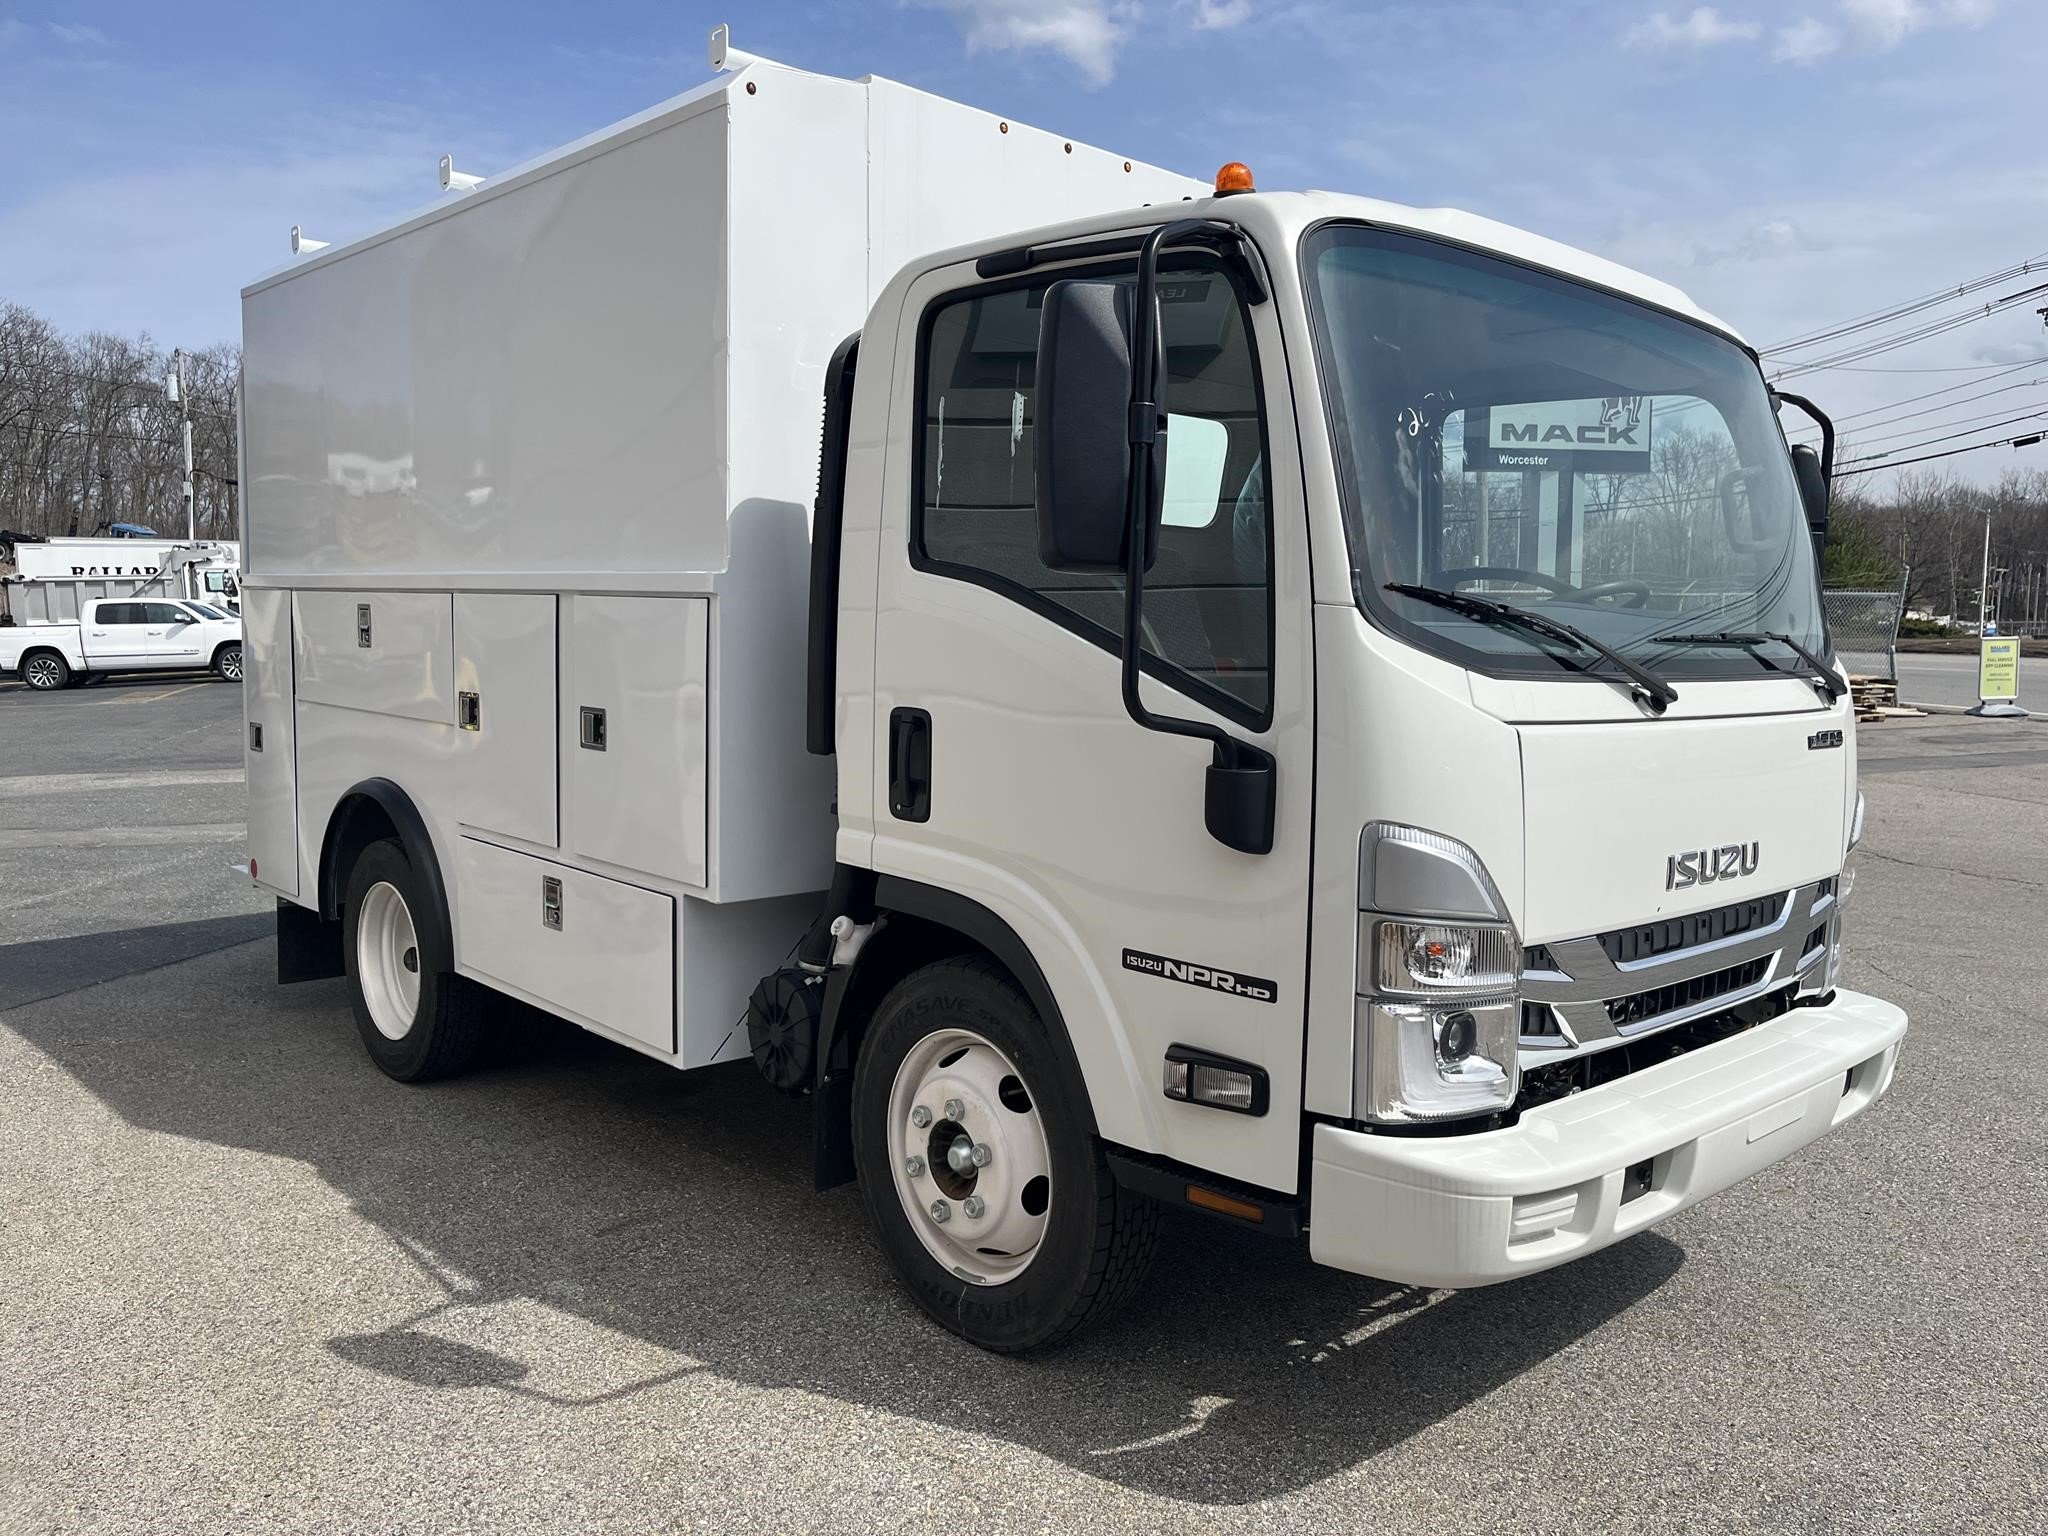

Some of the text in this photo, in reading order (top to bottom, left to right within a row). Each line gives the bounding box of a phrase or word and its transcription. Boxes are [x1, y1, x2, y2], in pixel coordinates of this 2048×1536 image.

[1501, 423, 1638, 444] MACK
[1499, 455, 1548, 465] Worcester
[71, 567, 158, 575] BALLAR
[1665, 840, 1759, 892] ISUZU
[1126, 955, 1271, 999] ISUZU NPR HD
